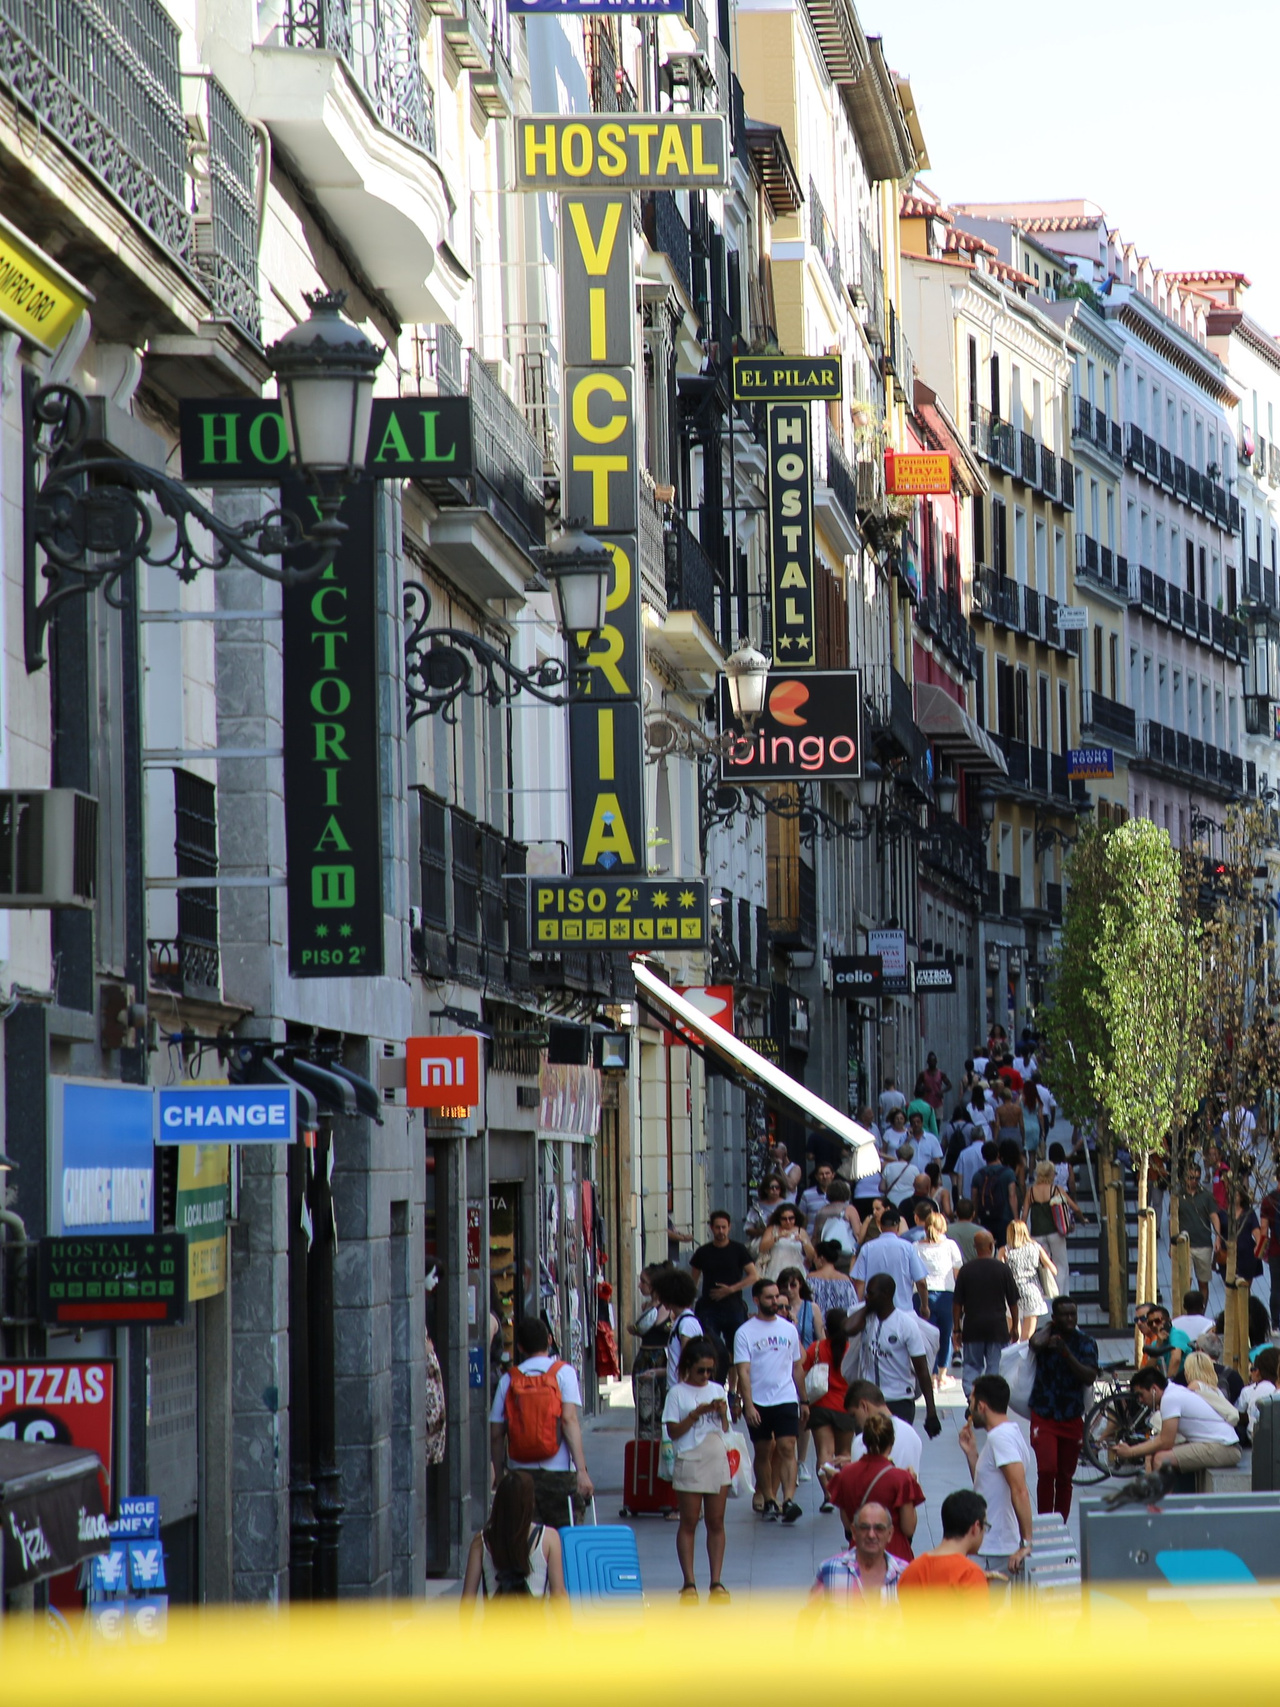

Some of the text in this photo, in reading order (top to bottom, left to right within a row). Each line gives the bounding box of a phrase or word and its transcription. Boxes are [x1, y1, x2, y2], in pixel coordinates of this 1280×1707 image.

[524, 123, 719, 177] HOSTAL
[26, 290, 55, 322] ORO
[741, 369, 835, 387] EL PILAR
[198, 411, 456, 465] HOAL
[899, 467, 943, 477] Playa
[776, 416, 808, 624] HOSTAL
[538, 888, 606, 913] PISO
[302, 949, 343, 964] PISO
[836, 970, 873, 983] celio
[164, 1105, 286, 1127] CHANGE
[52, 1243, 135, 1259] HOSTAL
[51, 1260, 153, 1277] VICTORIA
[0, 1367, 104, 1405] PIZZAS
